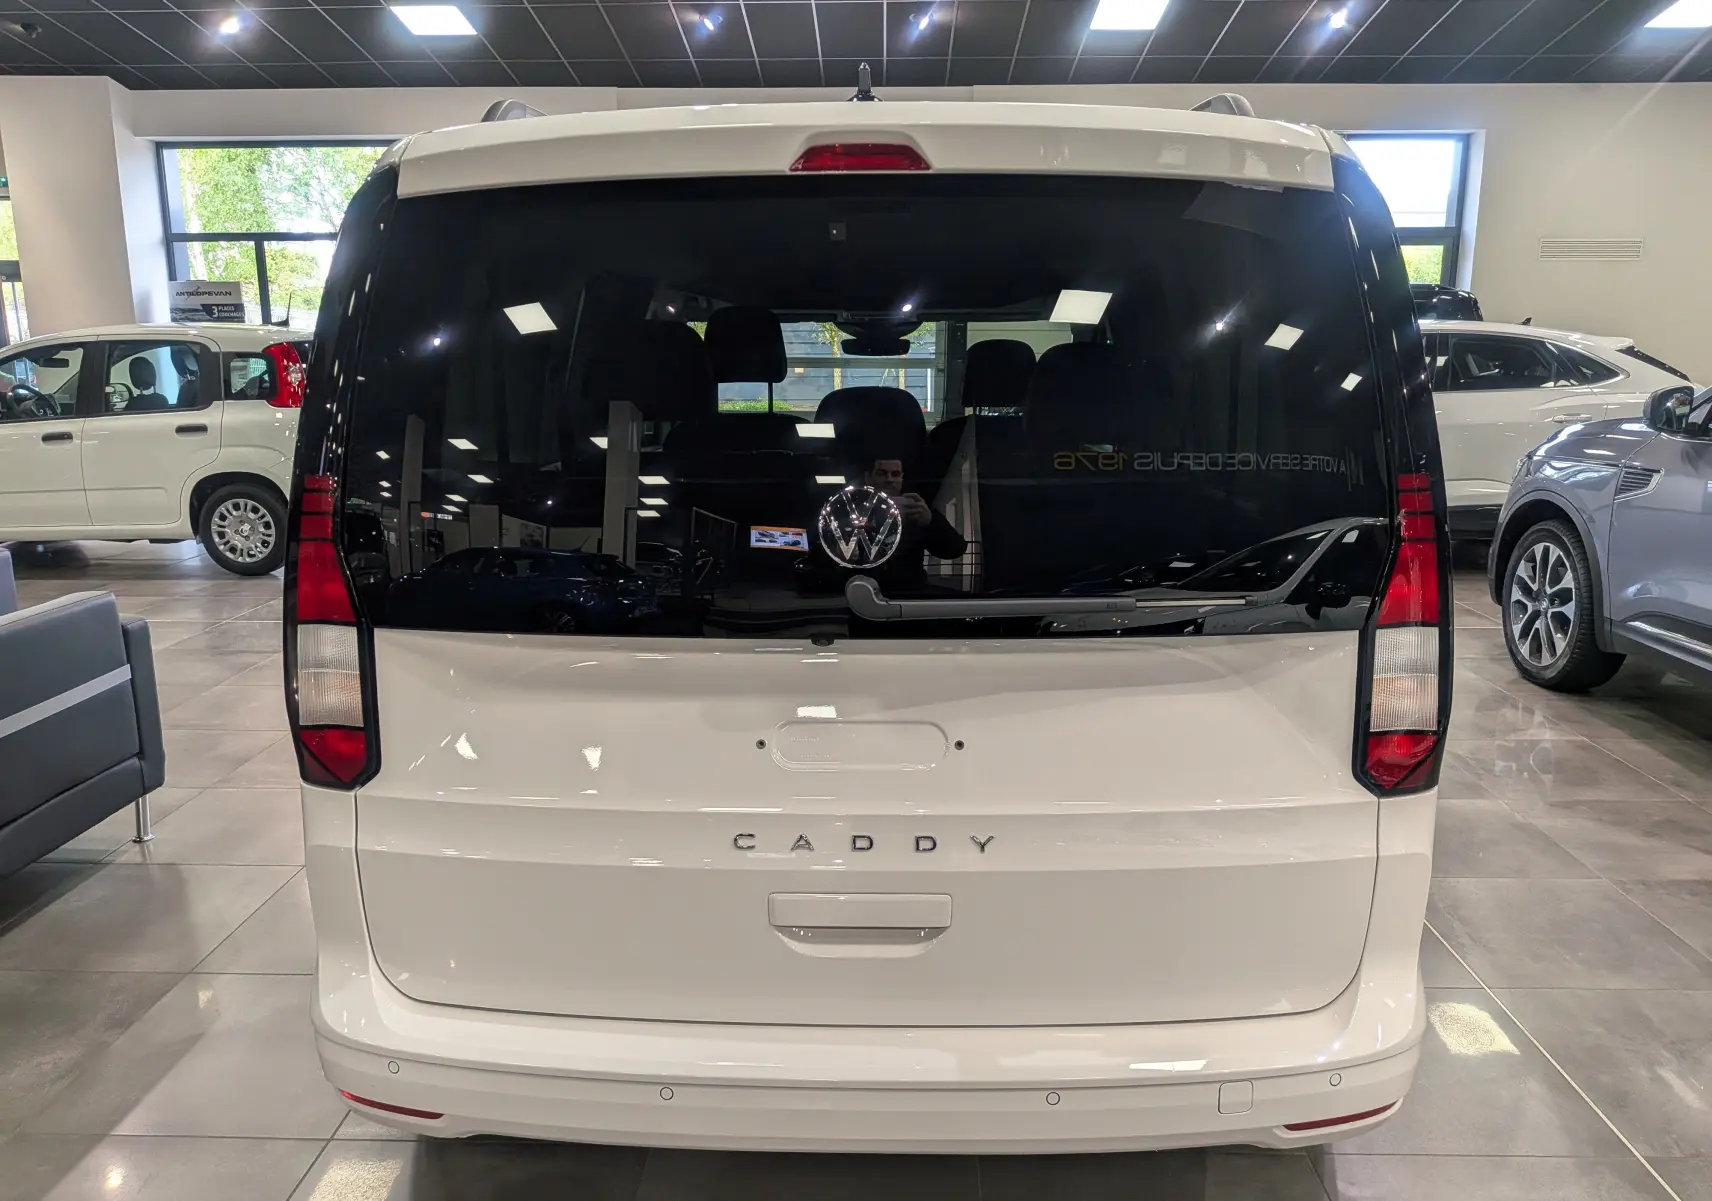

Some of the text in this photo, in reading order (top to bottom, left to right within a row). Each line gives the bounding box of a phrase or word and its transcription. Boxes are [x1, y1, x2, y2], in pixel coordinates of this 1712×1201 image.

[212, 305, 219, 318] 3
[820, 488, 900, 564] VW
[733, 833, 996, 853] CADDY
